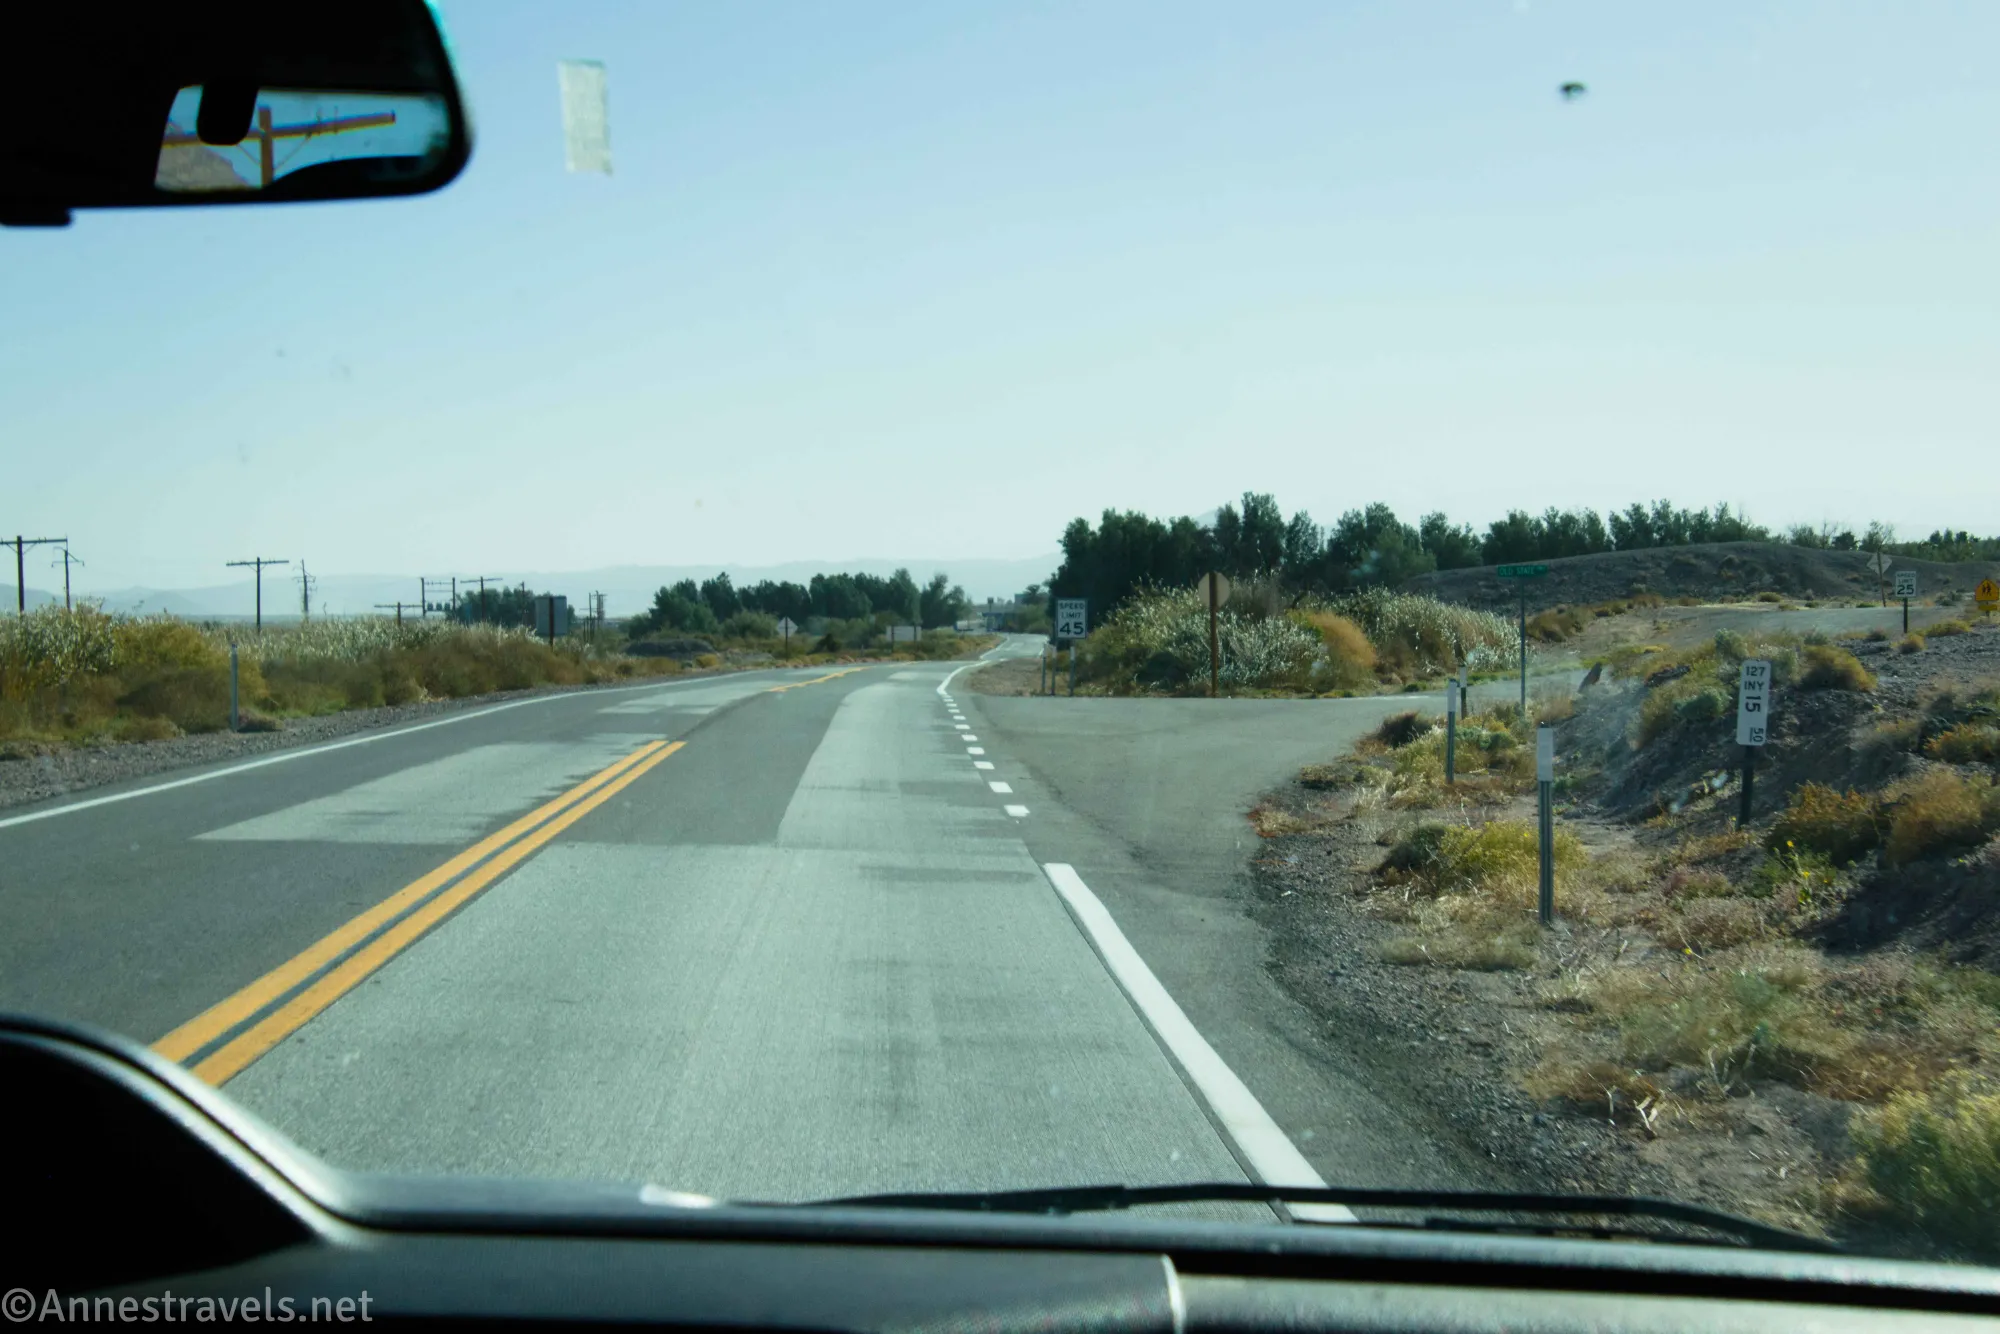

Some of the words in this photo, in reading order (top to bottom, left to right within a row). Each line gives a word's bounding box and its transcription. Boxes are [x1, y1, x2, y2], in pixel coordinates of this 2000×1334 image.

[1897, 584, 1914, 595] 25
[1059, 602, 1085, 610] SPEED
[1061, 611, 1081, 619] LIMIT
[1059, 622, 1084, 635] 45
[1745, 666, 1766, 677] 127
[1744, 680, 1765, 690] INY
[1745, 696, 1762, 713] 15
[1752, 727, 1764, 743] 50
